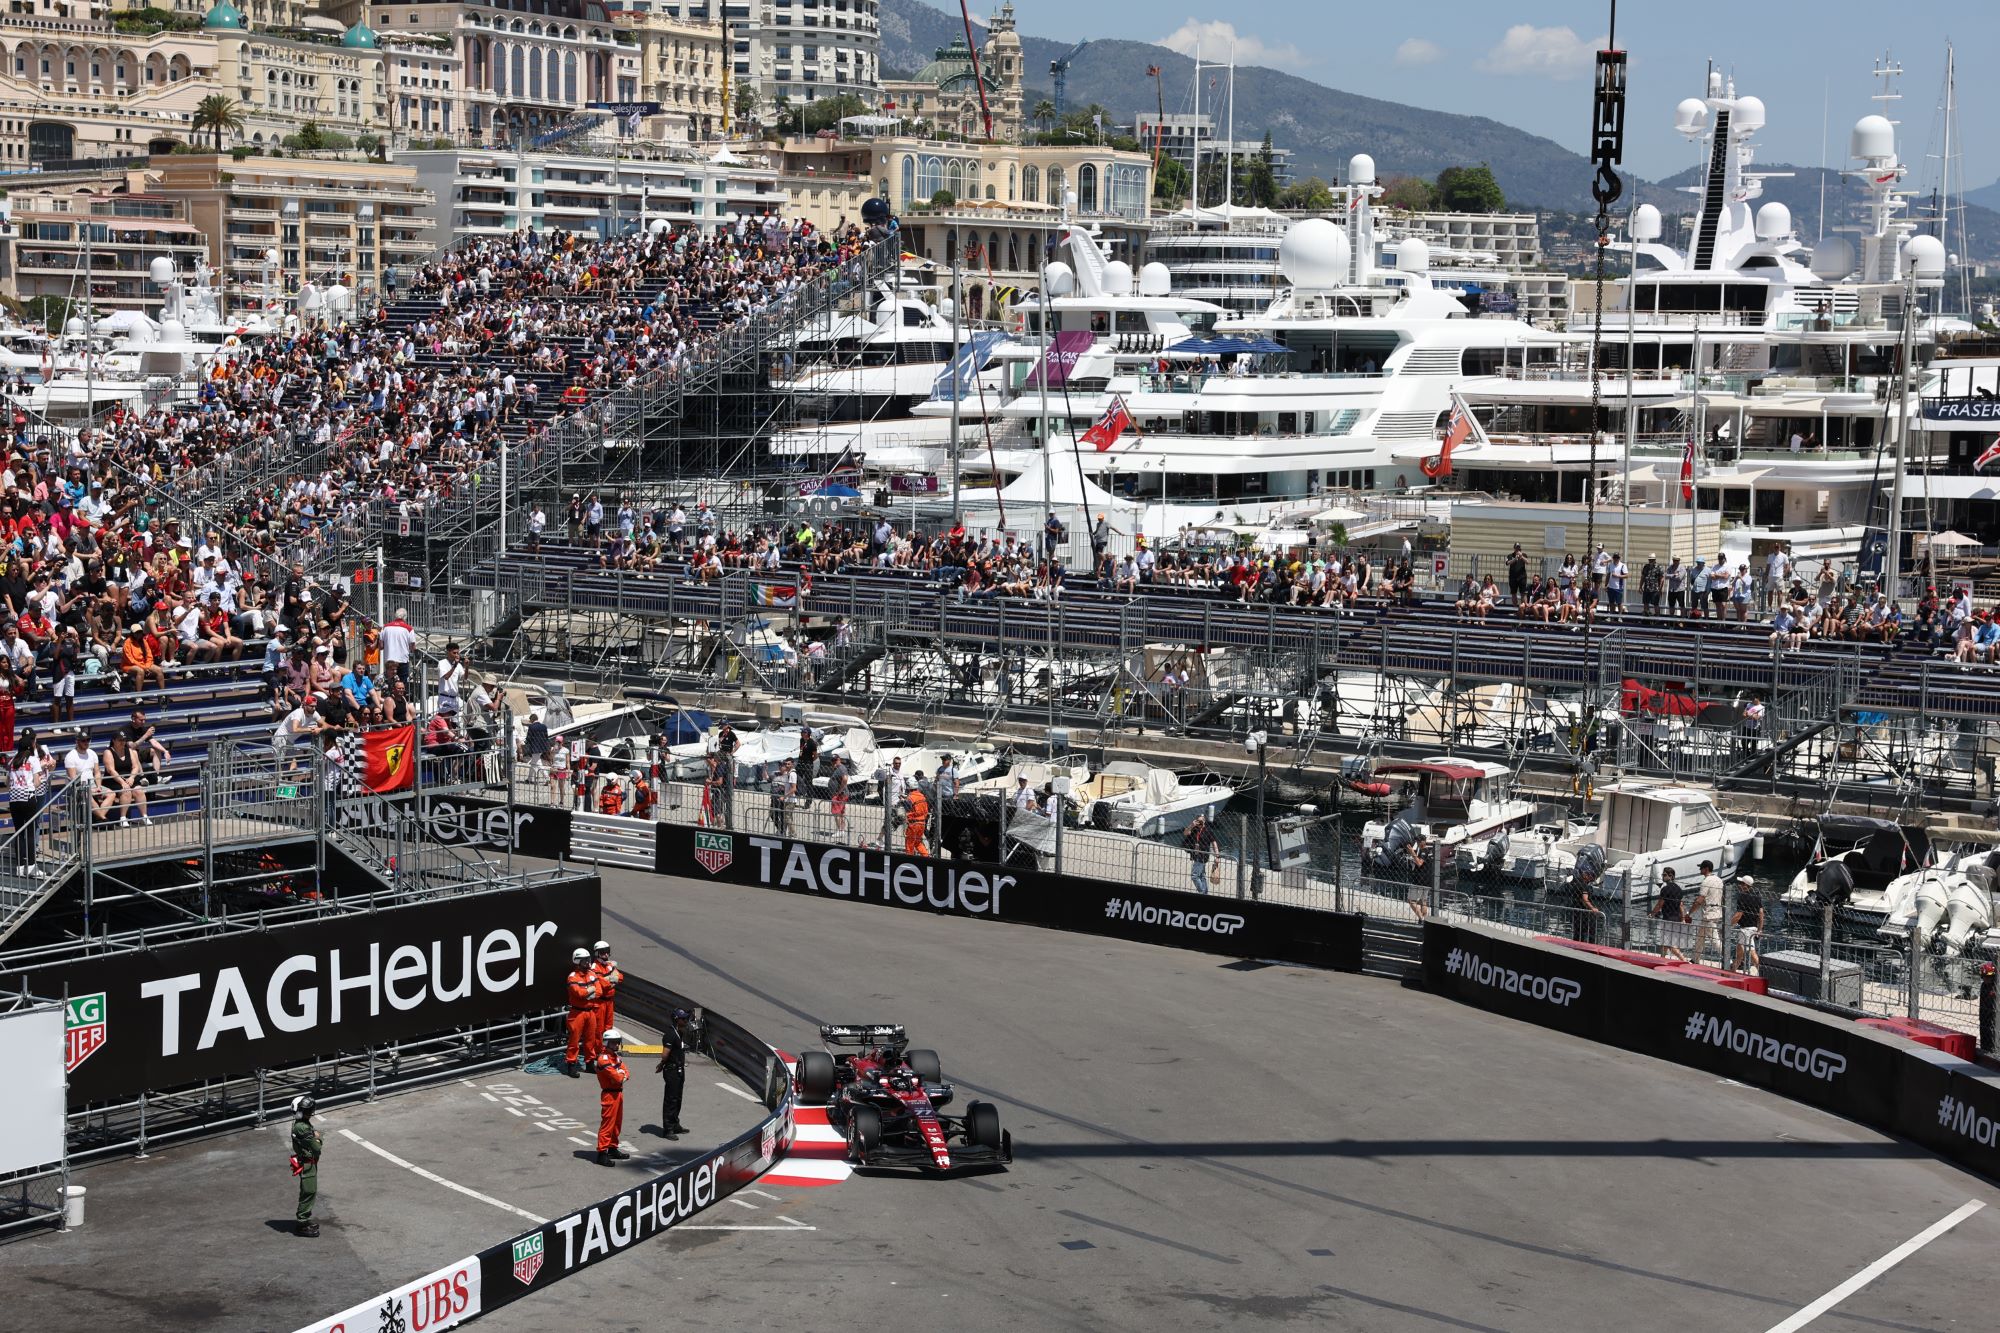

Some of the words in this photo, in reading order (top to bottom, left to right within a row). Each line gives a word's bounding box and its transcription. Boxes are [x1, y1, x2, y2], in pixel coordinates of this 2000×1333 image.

[611, 104, 648, 115] salesforce
[1938, 404, 2000, 417] FRASER
[400, 523, 408, 534] P
[1435, 560, 1445, 573] P
[698, 834, 729, 850] TAG
[696, 849, 731, 870] HEUER
[1104, 897, 1245, 935] #MonacoGP
[1445, 947, 1582, 1007] #MonacoGP
[1684, 1011, 1847, 1082] #MonacoGP
[515, 1235, 542, 1257] TAG
[514, 1254, 543, 1281] HEUER
[409, 1269, 470, 1332] UBS
